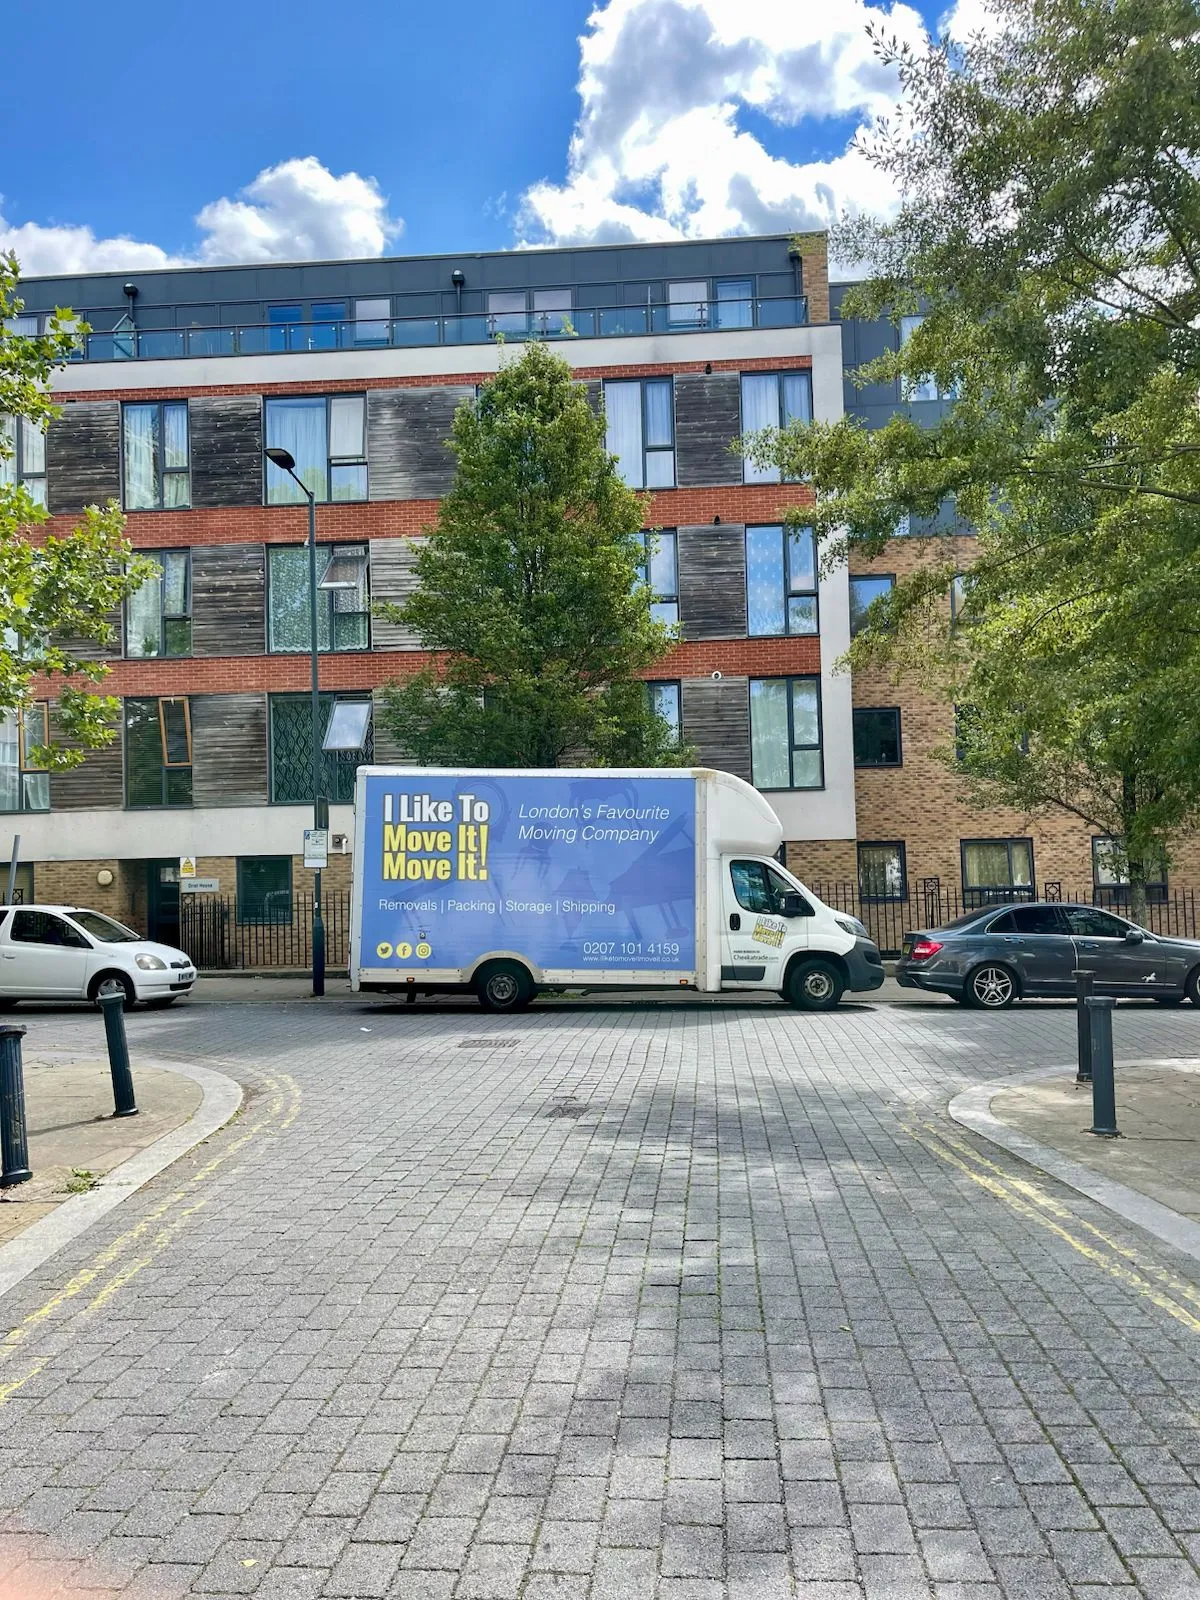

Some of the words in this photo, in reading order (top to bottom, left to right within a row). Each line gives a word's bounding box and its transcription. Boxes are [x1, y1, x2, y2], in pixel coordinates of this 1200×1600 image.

[384, 794, 393, 822] I
[400, 794, 453, 822] Like
[458, 794, 489, 822] To
[518, 804, 592, 819] London's
[596, 804, 670, 820] Favourite
[383, 824, 452, 852] Move
[518, 825, 577, 844] Moving
[582, 825, 660, 845] Company
[383, 852, 451, 880] Move
[379, 899, 438, 911] Removals
[447, 900, 496, 914] Packing
[505, 901, 552, 915] Storage
[562, 902, 616, 916] Shipping
[583, 942, 616, 954] 0207
[620, 942, 642, 954] 101
[647, 943, 680, 955] 4159
